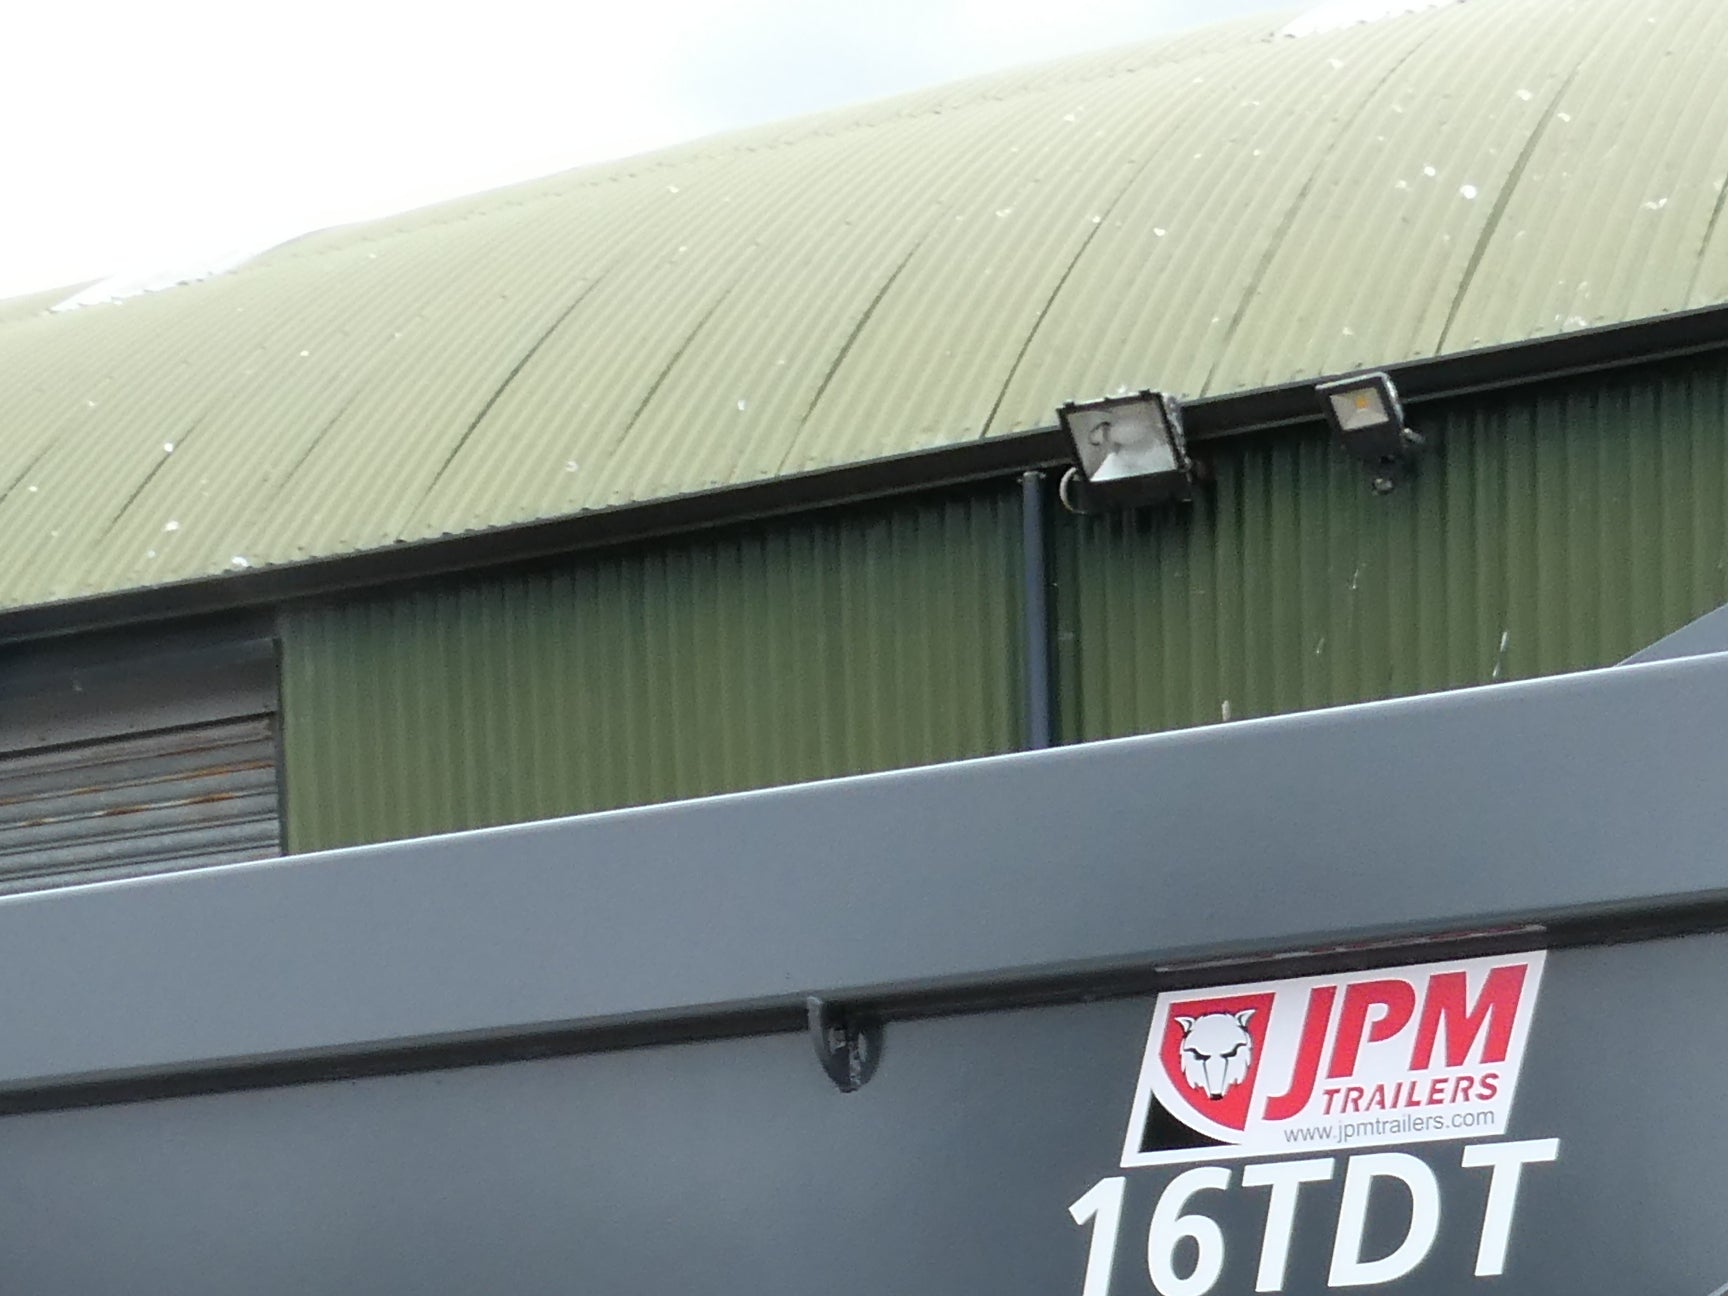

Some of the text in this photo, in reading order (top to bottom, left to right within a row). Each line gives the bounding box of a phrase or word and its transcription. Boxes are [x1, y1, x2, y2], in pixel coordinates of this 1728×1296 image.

[1262, 964, 1529, 1121] JPM
[1322, 1072, 1499, 1115] TRAILERS
[1283, 1109, 1495, 1145] www.jpmtrailers.com
